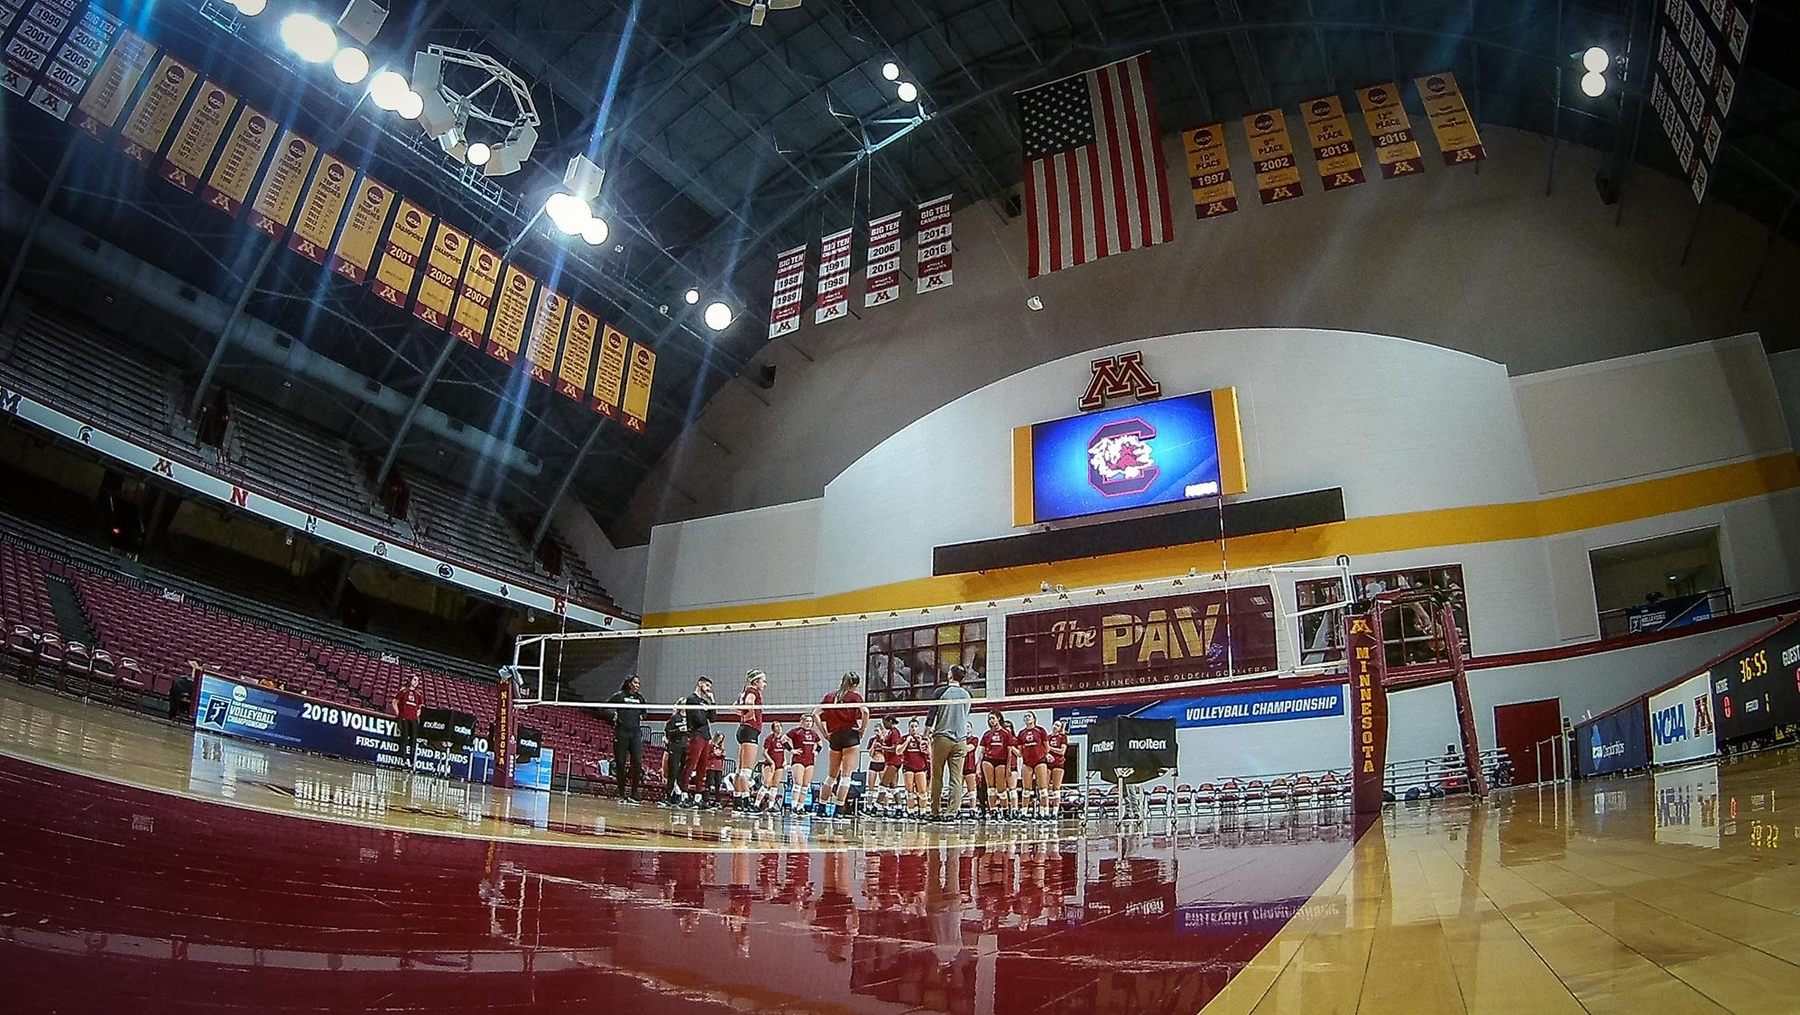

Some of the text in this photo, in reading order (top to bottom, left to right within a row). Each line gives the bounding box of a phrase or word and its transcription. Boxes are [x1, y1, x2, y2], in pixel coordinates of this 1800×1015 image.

[37, 8, 61, 28] 1999
[24, 25, 49, 45] 2001
[75, 32, 101, 52] 2003
[13, 43, 40, 64] 2002
[53, 67, 80, 87] 2007
[1375, 119, 1401, 130] PLACE
[1316, 130, 1344, 142] PLACE
[1378, 131, 1408, 147] 2016
[1258, 144, 1285, 155] PLACE
[1320, 142, 1349, 158] 2013
[1196, 159, 1220, 171] PLACE
[1260, 157, 1290, 172] 2002
[1198, 172, 1225, 187] 1997
[920, 203, 950, 219] BIG TEN
[871, 220, 900, 237] BIG TEN
[924, 226, 946, 240] 2014
[823, 237, 849, 252] BIG TEN
[873, 243, 895, 257] 2006
[923, 244, 946, 259] 2016
[389, 245, 413, 264] 2001
[779, 253, 804, 268] BIG TEN
[825, 260, 844, 273] 1991
[872, 261, 894, 275] 2013
[429, 267, 453, 287] 2002
[823, 276, 844, 290] 1998
[465, 287, 487, 305] 2007
[777, 293, 797, 305] 1989
[230, 486, 250, 508] N
[1050, 603, 1221, 666] The PAV
[1739, 650, 1768, 683] 36:55
[229, 705, 275, 725] VOLLEYBALL
[302, 703, 339, 724] 2018
[1186, 696, 1337, 721] VOLLEYBALL CHAMPIONSHIP
[1355, 646, 1375, 773] MINNESOTA
[499, 691, 507, 765] MINNESOTA
[1652, 702, 1687, 746] NCAA
[356, 735, 380, 750] FIRST
[380, 741, 399, 752] AND
[1128, 738, 1167, 750] molten
